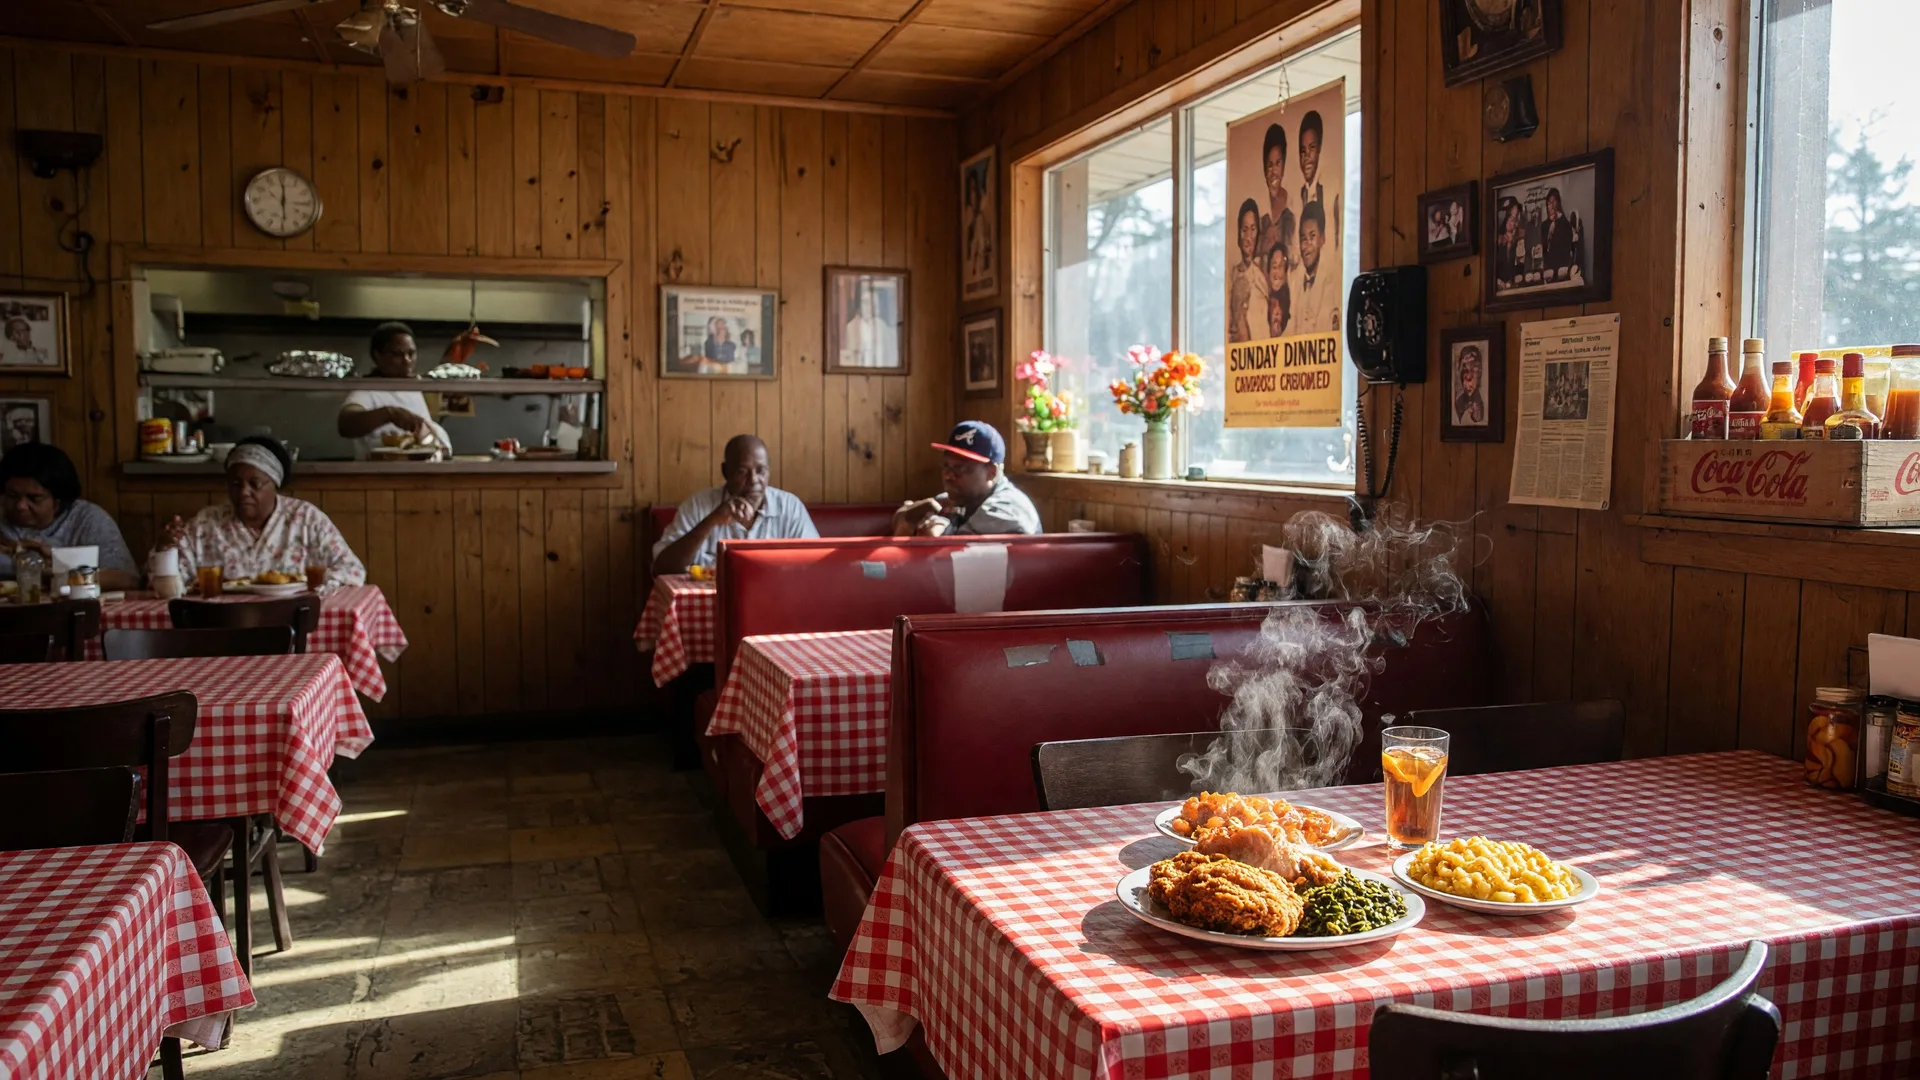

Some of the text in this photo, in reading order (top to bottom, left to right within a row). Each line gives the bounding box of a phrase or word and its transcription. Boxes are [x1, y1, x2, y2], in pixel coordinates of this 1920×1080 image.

[1230, 338, 1337, 372] SUNDAY DINNER
[1691, 449, 1814, 500] Coca-Cola
